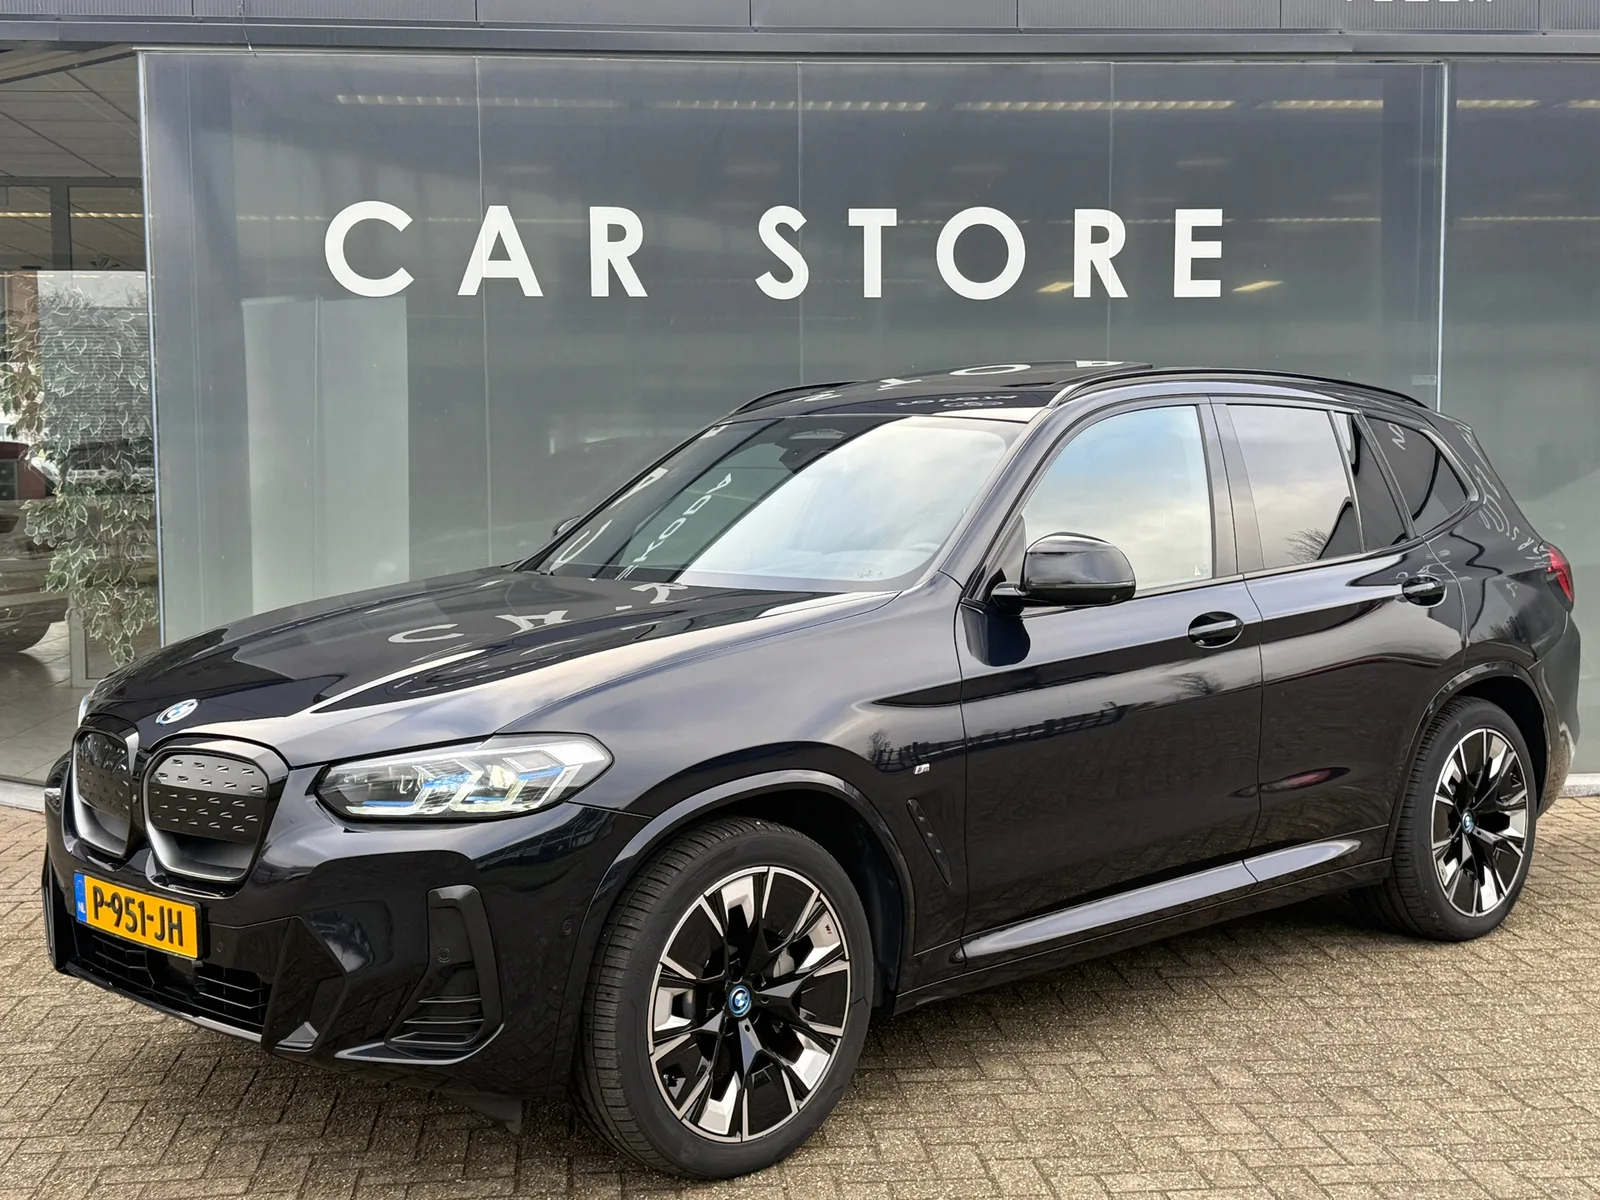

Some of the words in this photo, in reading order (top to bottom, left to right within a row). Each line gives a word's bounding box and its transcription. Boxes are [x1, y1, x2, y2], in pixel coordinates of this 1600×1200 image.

[324, 200, 648, 297] CAR
[755, 205, 1223, 300] STORE
[77, 901, 86, 914] NL
[93, 885, 184, 947] P-951-JH
